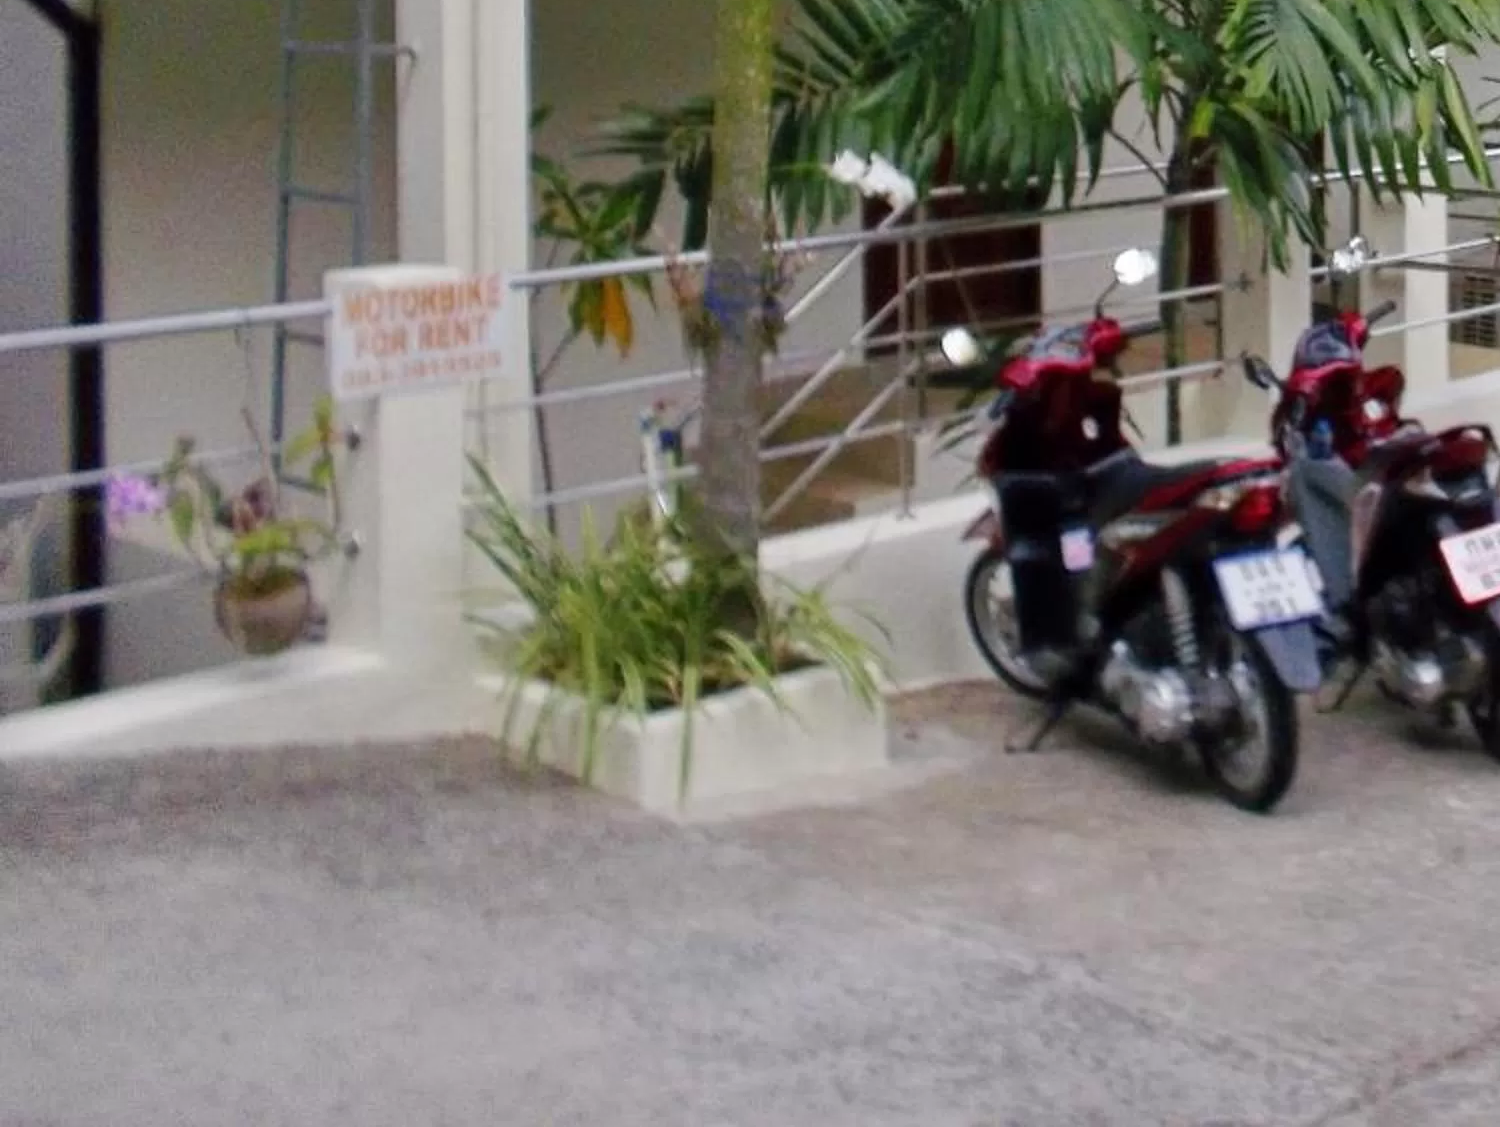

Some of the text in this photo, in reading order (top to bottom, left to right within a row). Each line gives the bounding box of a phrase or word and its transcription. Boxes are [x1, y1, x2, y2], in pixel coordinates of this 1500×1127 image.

[343, 274, 503, 322] MOTORBIKE
[355, 314, 488, 357] FOR RENT
